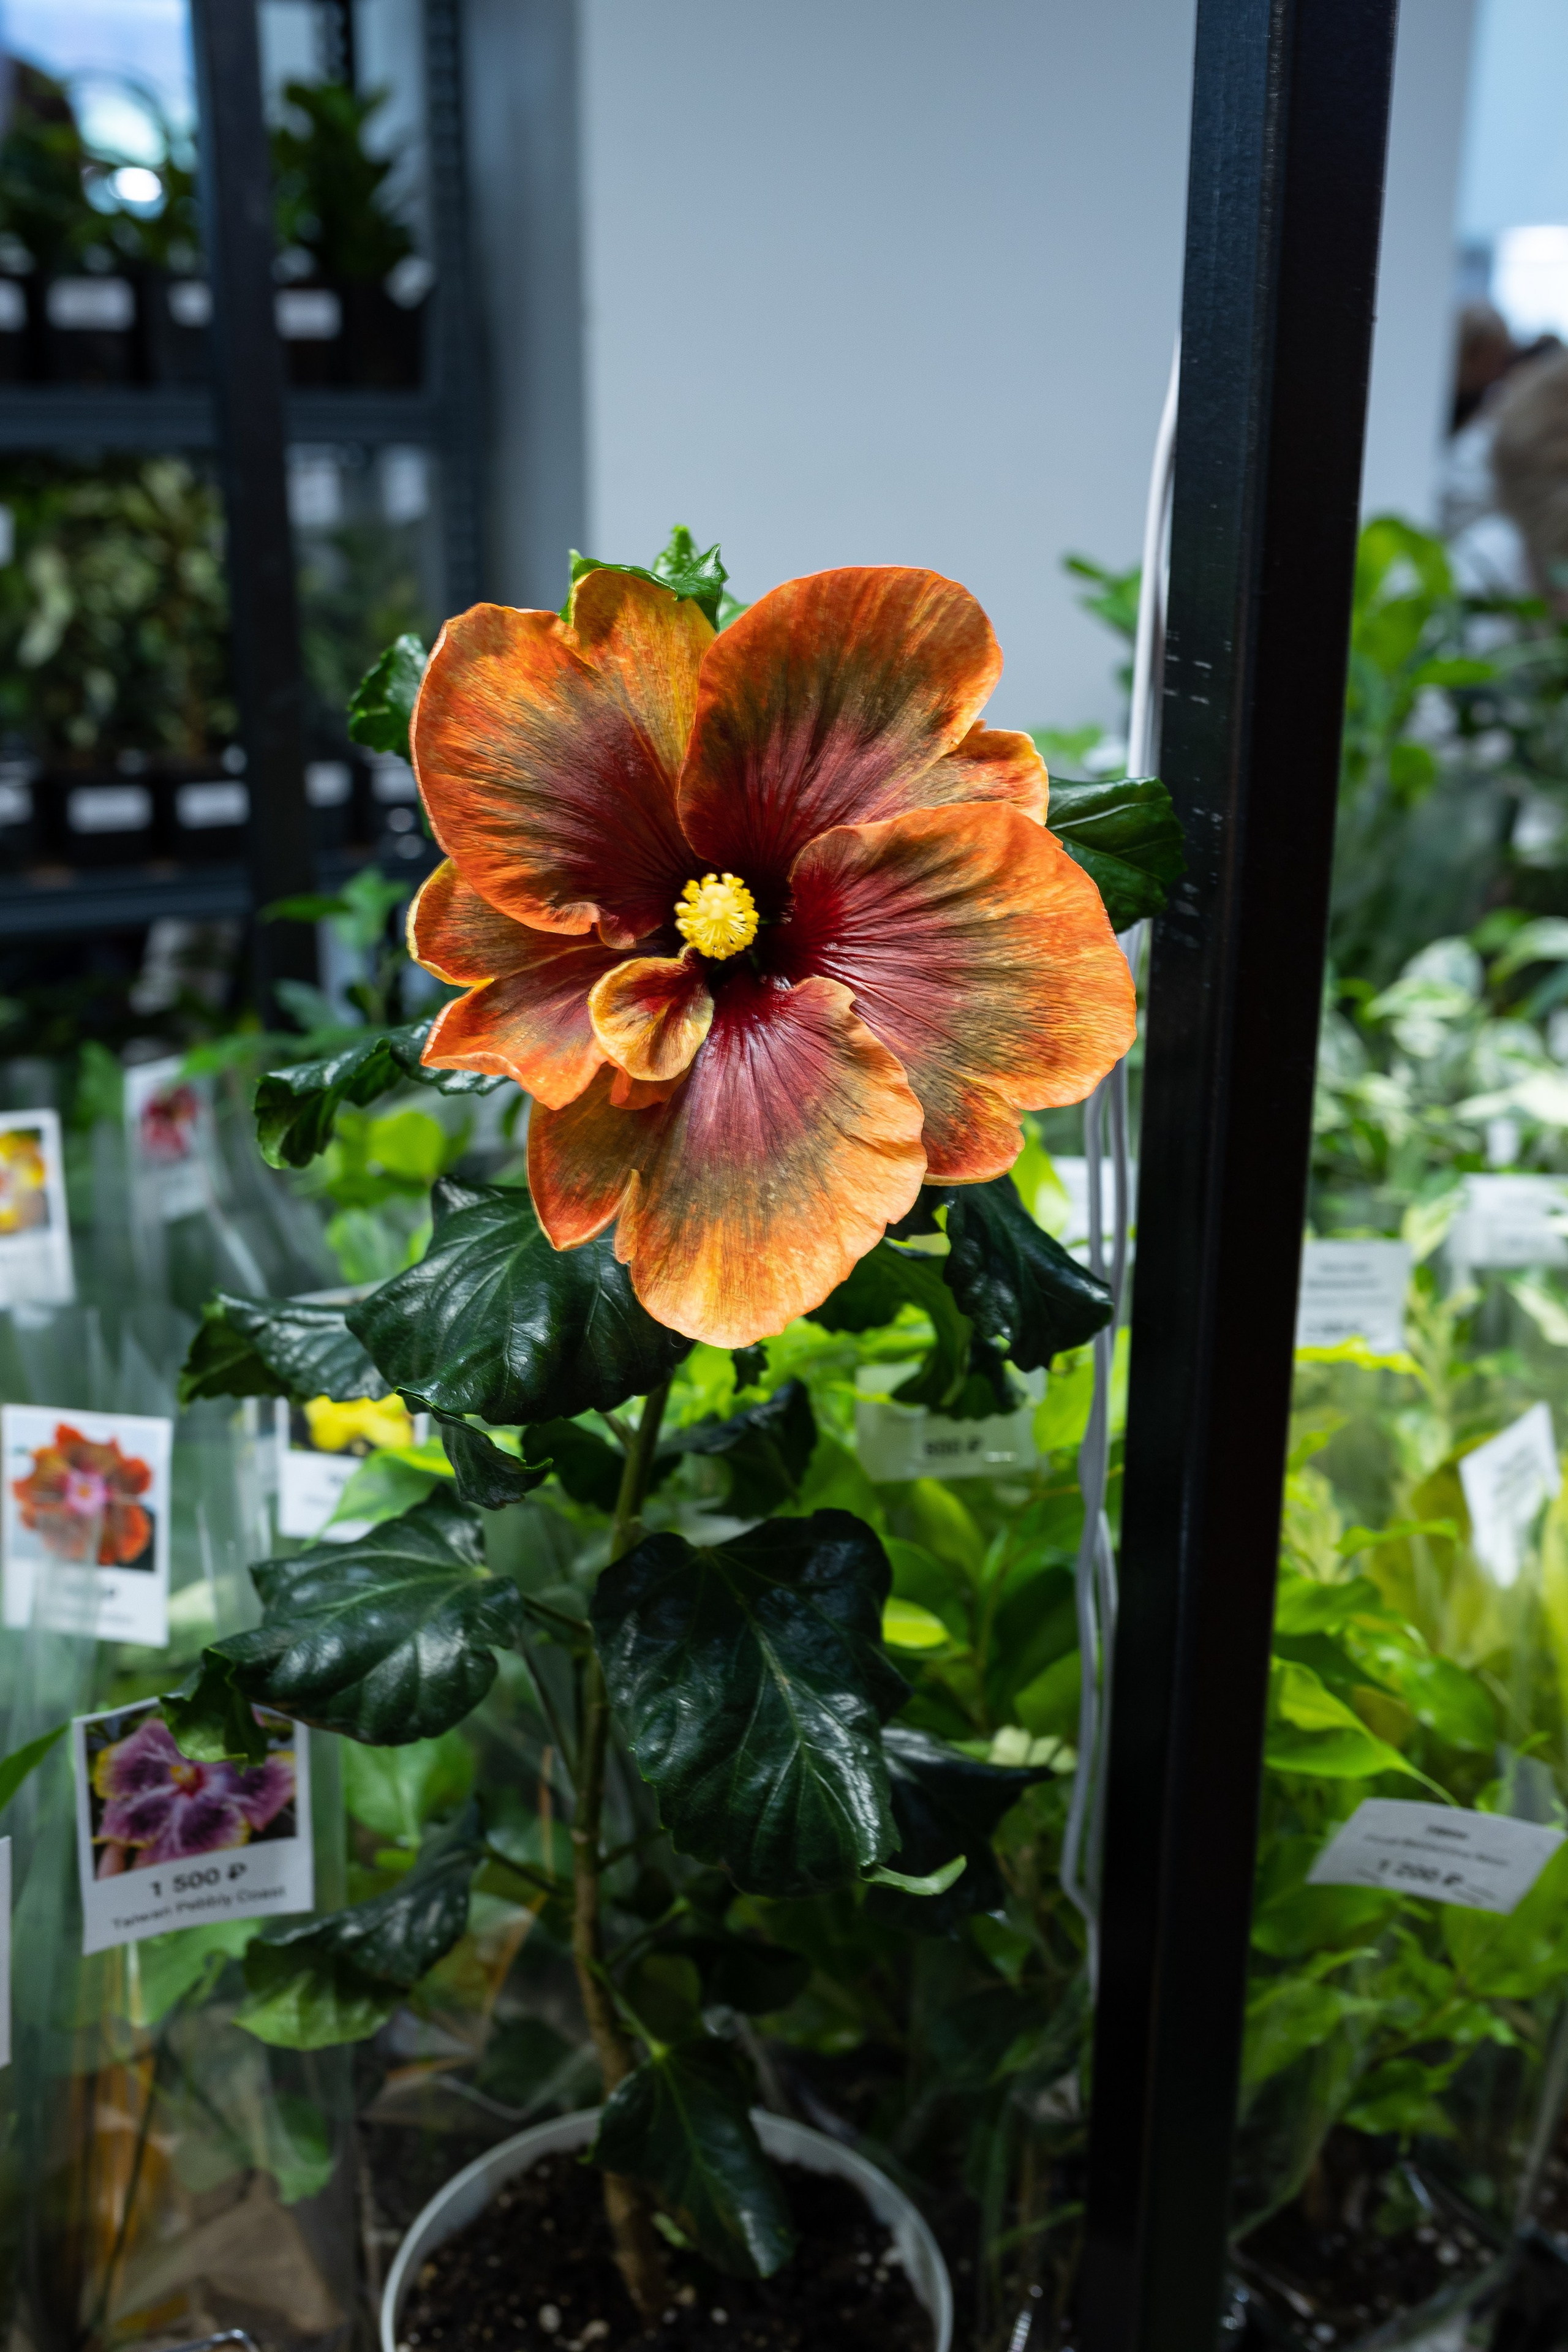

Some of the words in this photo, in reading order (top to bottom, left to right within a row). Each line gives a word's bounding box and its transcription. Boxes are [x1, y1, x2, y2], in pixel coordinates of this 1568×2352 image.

[151, 1880, 162, 1896] 1
[173, 1868, 221, 1893] 500
[227, 1862, 247, 1880] ₽
[113, 1906, 171, 1928] Taiwan
[236, 1885, 286, 1902] Coast
